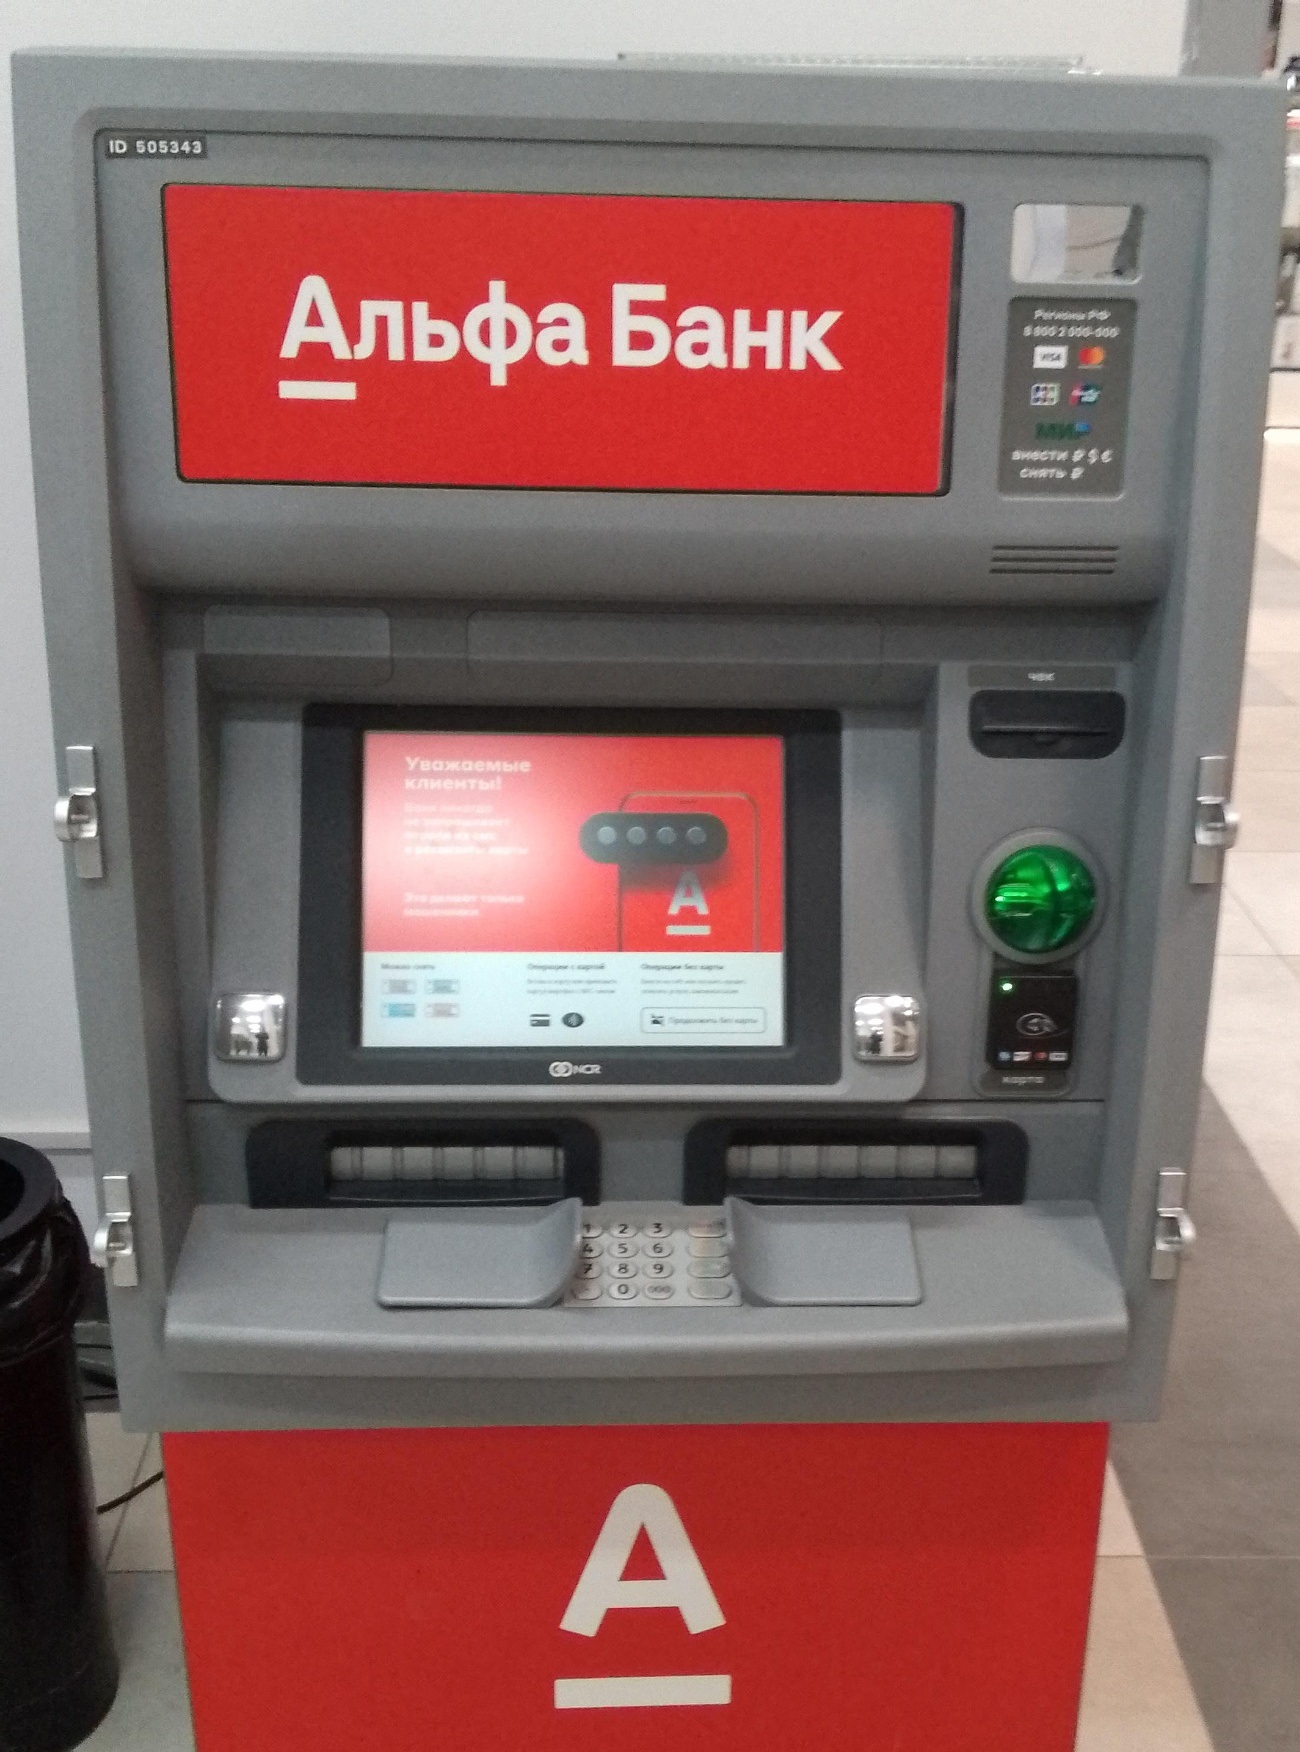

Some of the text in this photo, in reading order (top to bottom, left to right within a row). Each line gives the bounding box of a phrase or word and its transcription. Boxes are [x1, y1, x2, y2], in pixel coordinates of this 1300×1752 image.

[109, 139, 202, 155] ID 505343
[278, 274, 844, 387] Альфа Банк
[404, 756, 531, 773] Уважаемые
[404, 775, 503, 791] клиенты!
[572, 1064, 602, 1075] NCR
[618, 1223, 628, 1234] 2
[653, 1222, 663, 1234] 3
[617, 1243, 628, 1254] 5
[653, 1243, 663, 1254] 6
[618, 1263, 629, 1274] 8
[653, 1263, 664, 1274] 9
